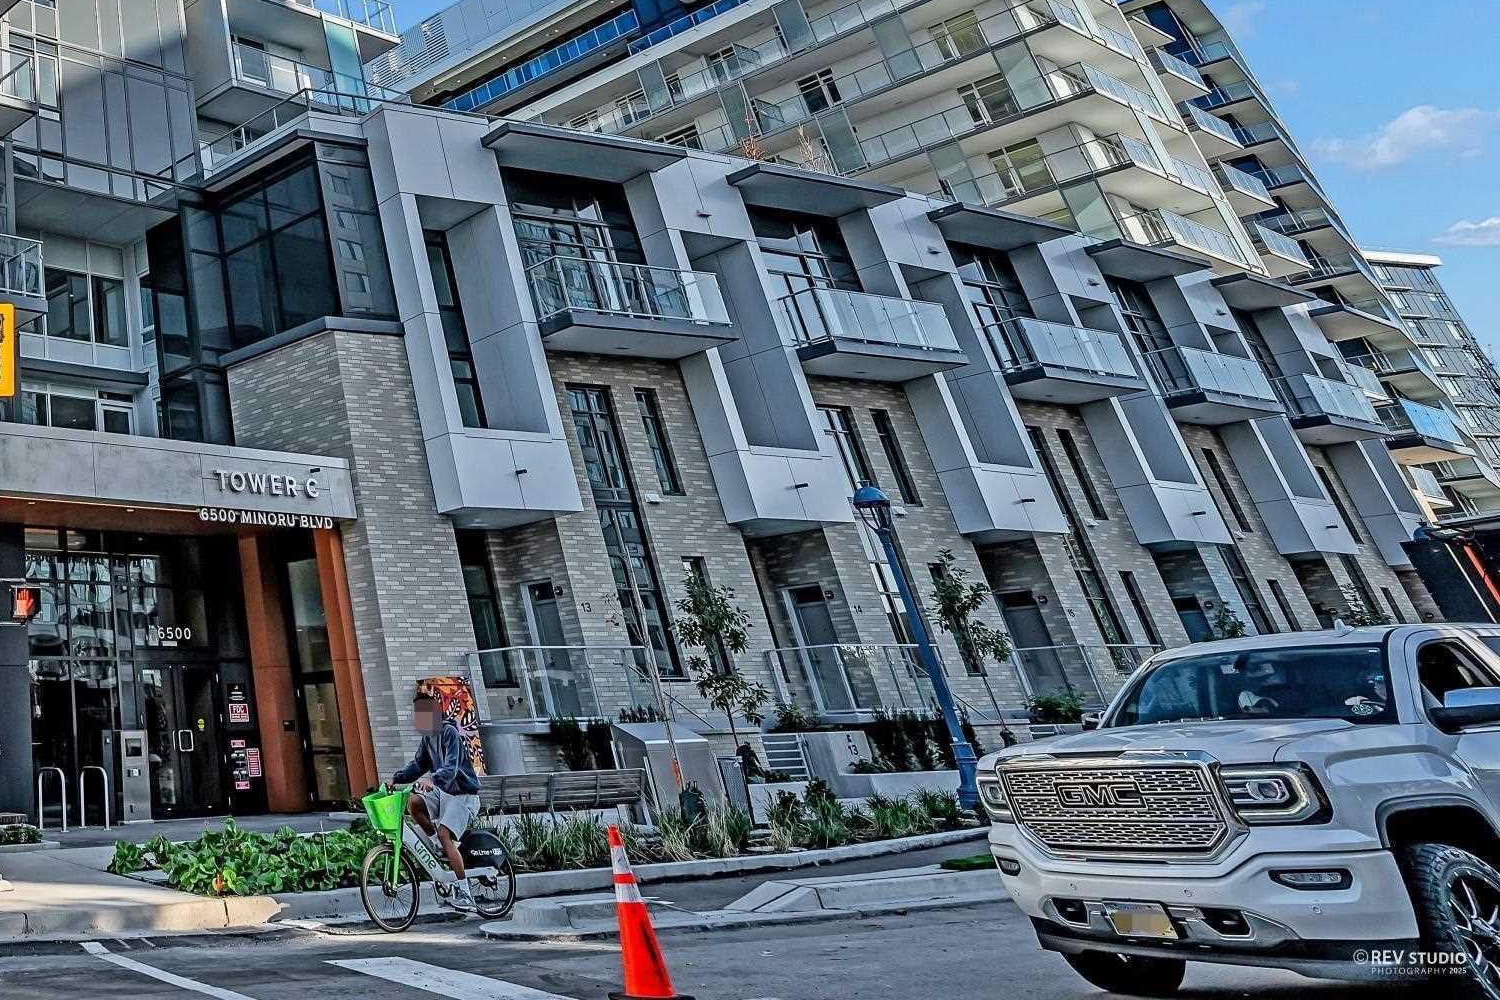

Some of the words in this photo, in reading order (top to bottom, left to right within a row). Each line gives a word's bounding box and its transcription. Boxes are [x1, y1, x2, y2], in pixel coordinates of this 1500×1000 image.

[214, 469, 298, 497] TOWER
[305, 478, 320, 498] C
[200, 507, 236, 522] 6500
[240, 510, 296, 527] MINORU
[300, 515, 334, 529] BLVD
[580, 602, 592, 613] 13
[158, 626, 191, 640] 6500
[847, 744, 859, 755] 13
[1057, 785, 1141, 805] GMC
